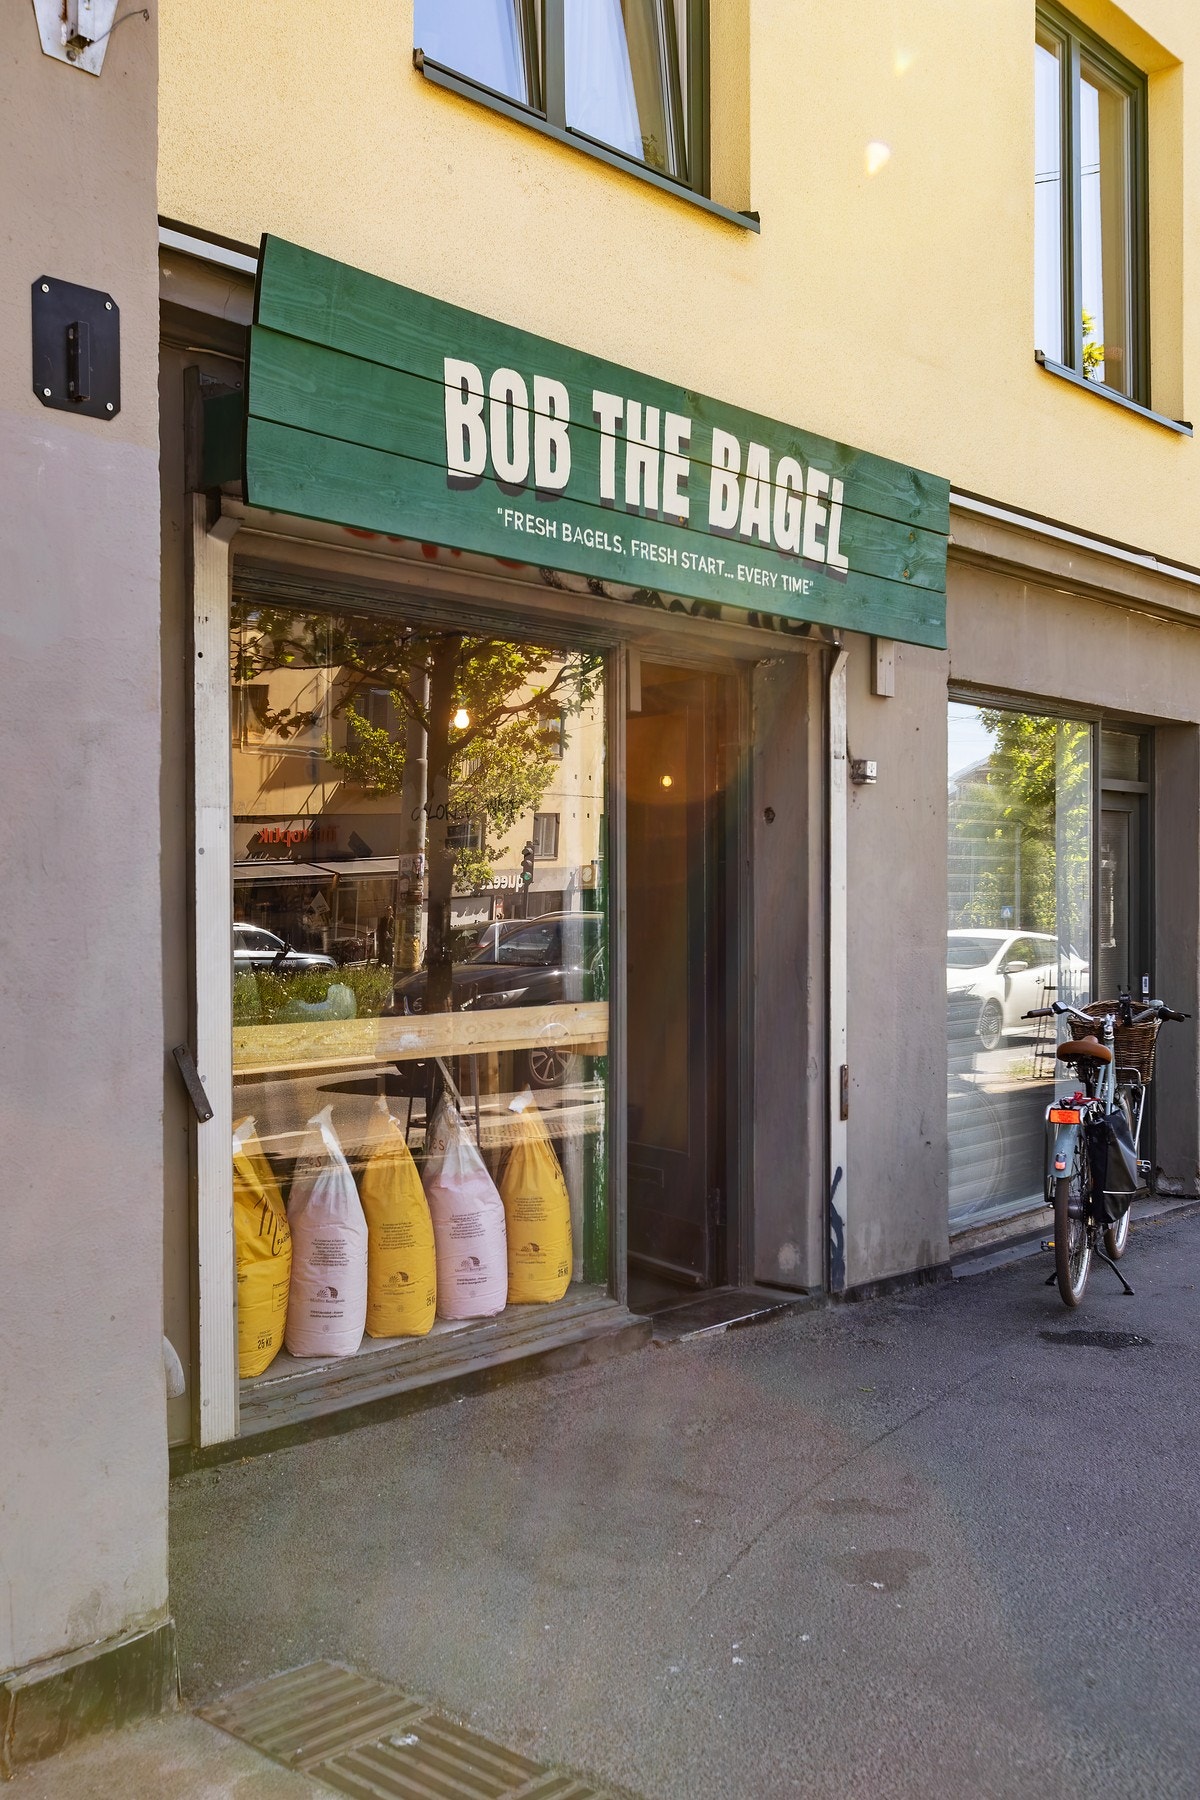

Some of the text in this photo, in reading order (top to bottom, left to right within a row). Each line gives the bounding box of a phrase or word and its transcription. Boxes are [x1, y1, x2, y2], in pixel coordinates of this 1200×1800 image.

[444, 357, 849, 574] BOB THE BAGEL
[631, 539, 677, 566] FRESH
[681, 551, 734, 579] START...
[737, 564, 778, 588] EVERY
[257, 1338, 264, 1350] 25
